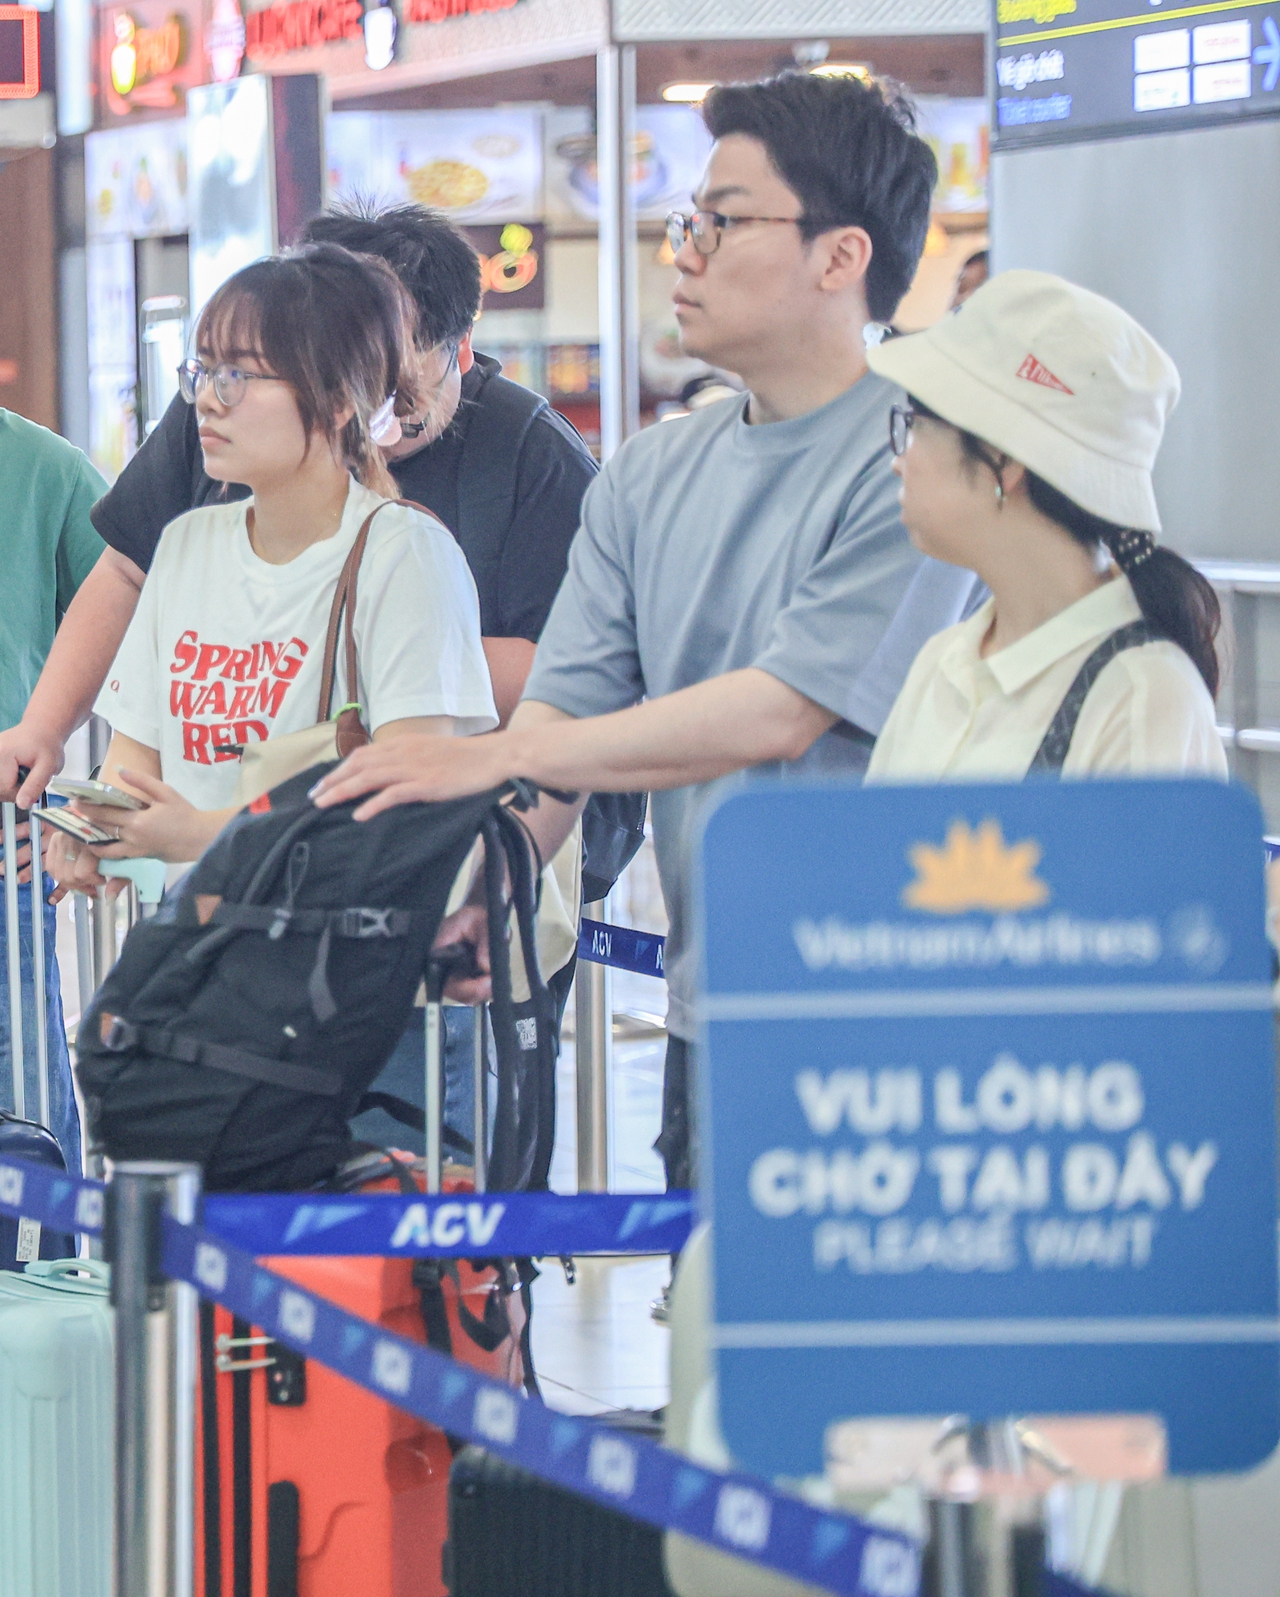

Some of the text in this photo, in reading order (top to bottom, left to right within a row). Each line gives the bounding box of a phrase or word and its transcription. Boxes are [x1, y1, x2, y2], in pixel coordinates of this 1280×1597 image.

[170, 629, 309, 683] SPRING
[170, 676, 291, 720] WARM
[182, 720, 269, 765] RED
[592, 929, 612, 958] ACV
[794, 1052, 1145, 1136] VUI LÒNG
[748, 1137, 920, 1217] CHỜ
[1061, 1130, 1219, 1212] ĐÂY
[390, 1202, 507, 1248] ACV
[813, 1214, 1158, 1273] PLEASE WAIT
